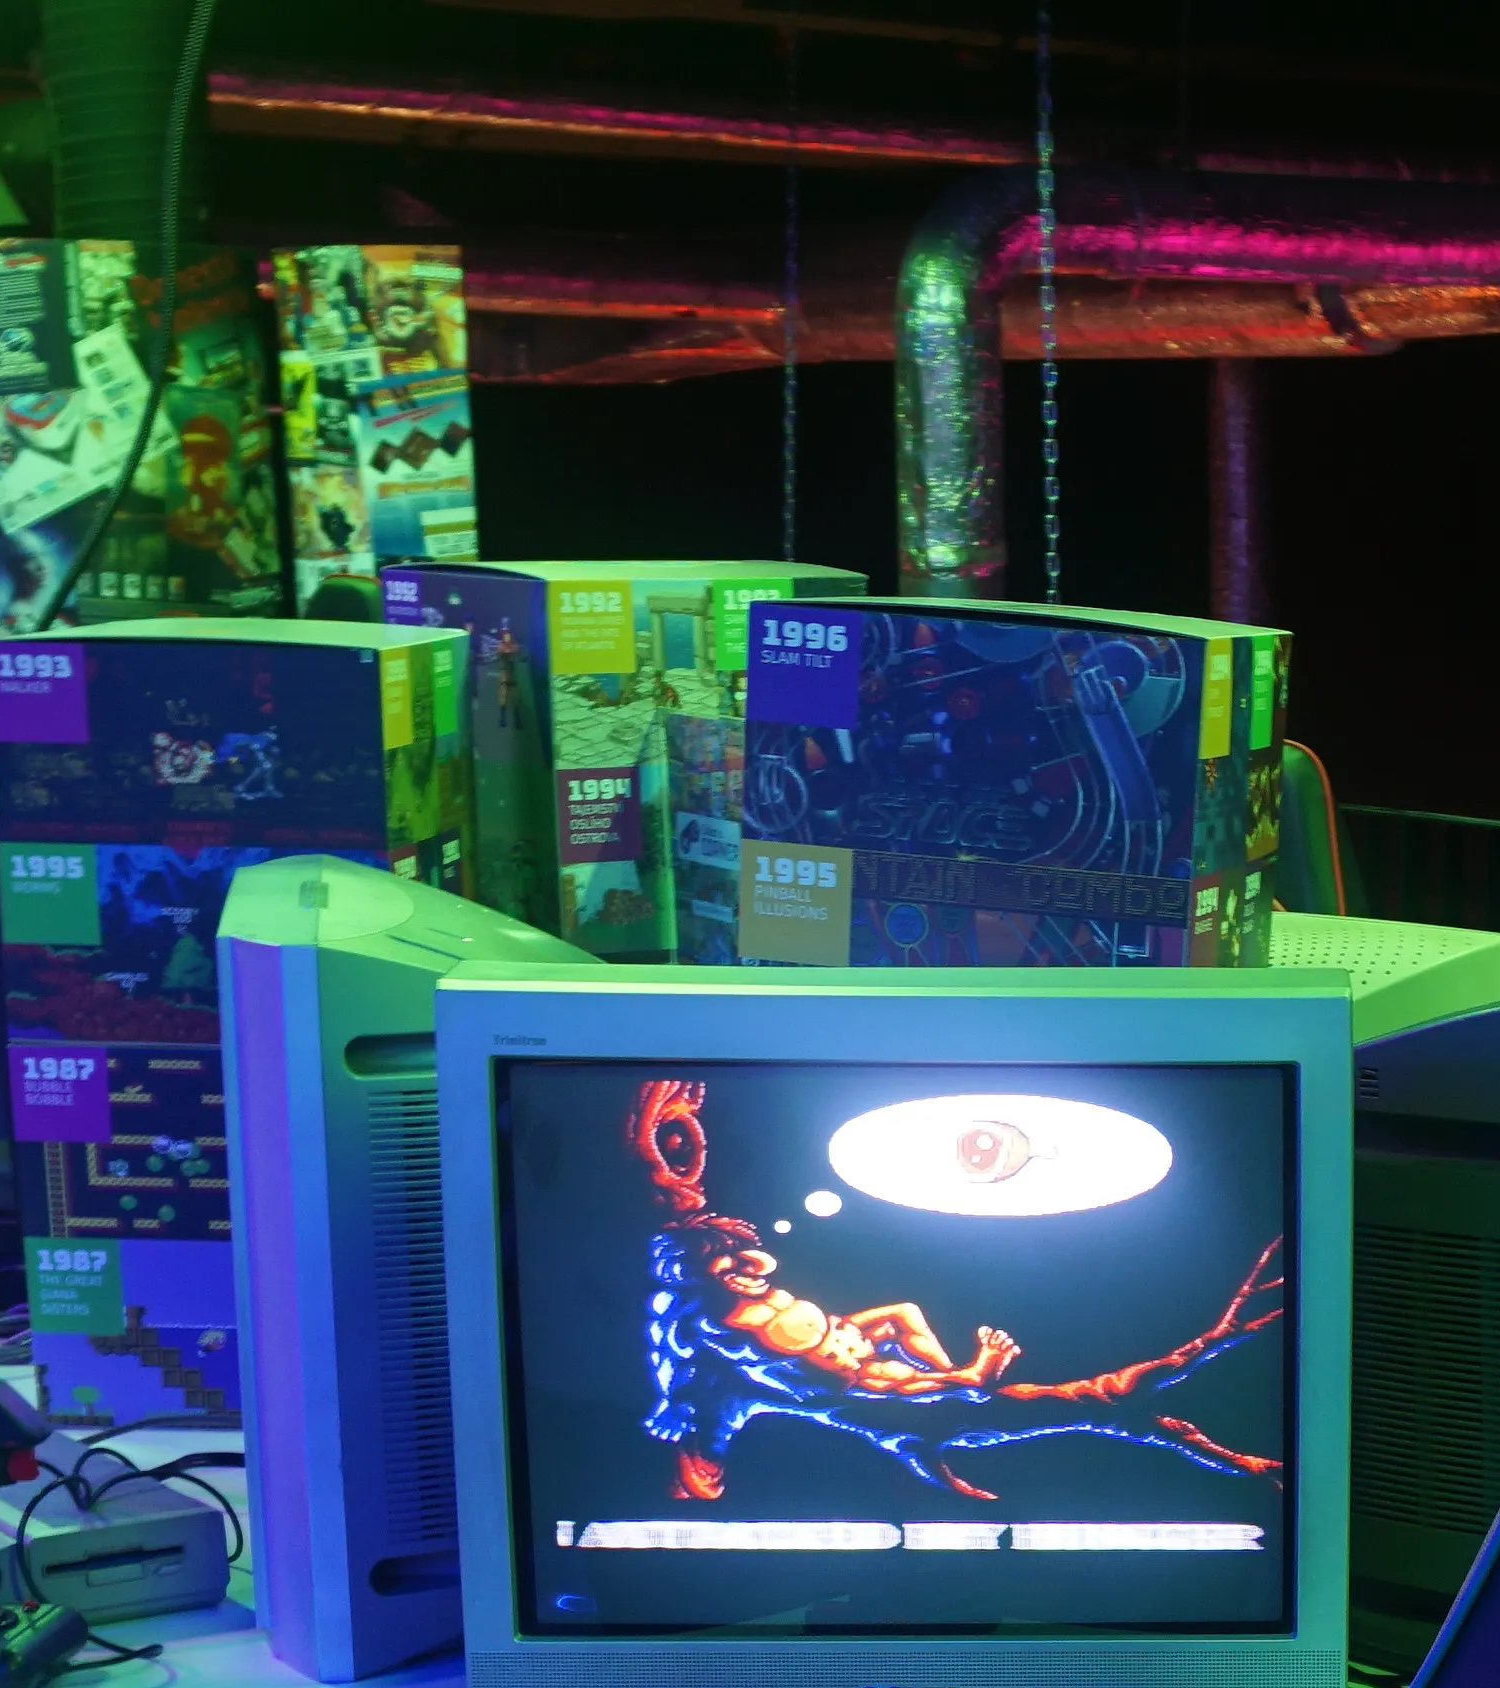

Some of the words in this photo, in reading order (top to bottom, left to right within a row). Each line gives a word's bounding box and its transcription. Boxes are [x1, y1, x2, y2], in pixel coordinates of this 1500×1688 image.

[559, 591, 622, 613] 1992
[762, 619, 848, 651] 1996
[760, 649, 801, 666] SLAM
[805, 655, 834, 669] TILT
[568, 778, 631, 801] 1994
[11, 855, 84, 879] 1995
[753, 856, 838, 888] 1995
[754, 884, 812, 903] PINBALL
[753, 903, 828, 922] ILLUSIONS
[22, 1056, 94, 1081] 1987
[36, 1248, 108, 1272] 1987
